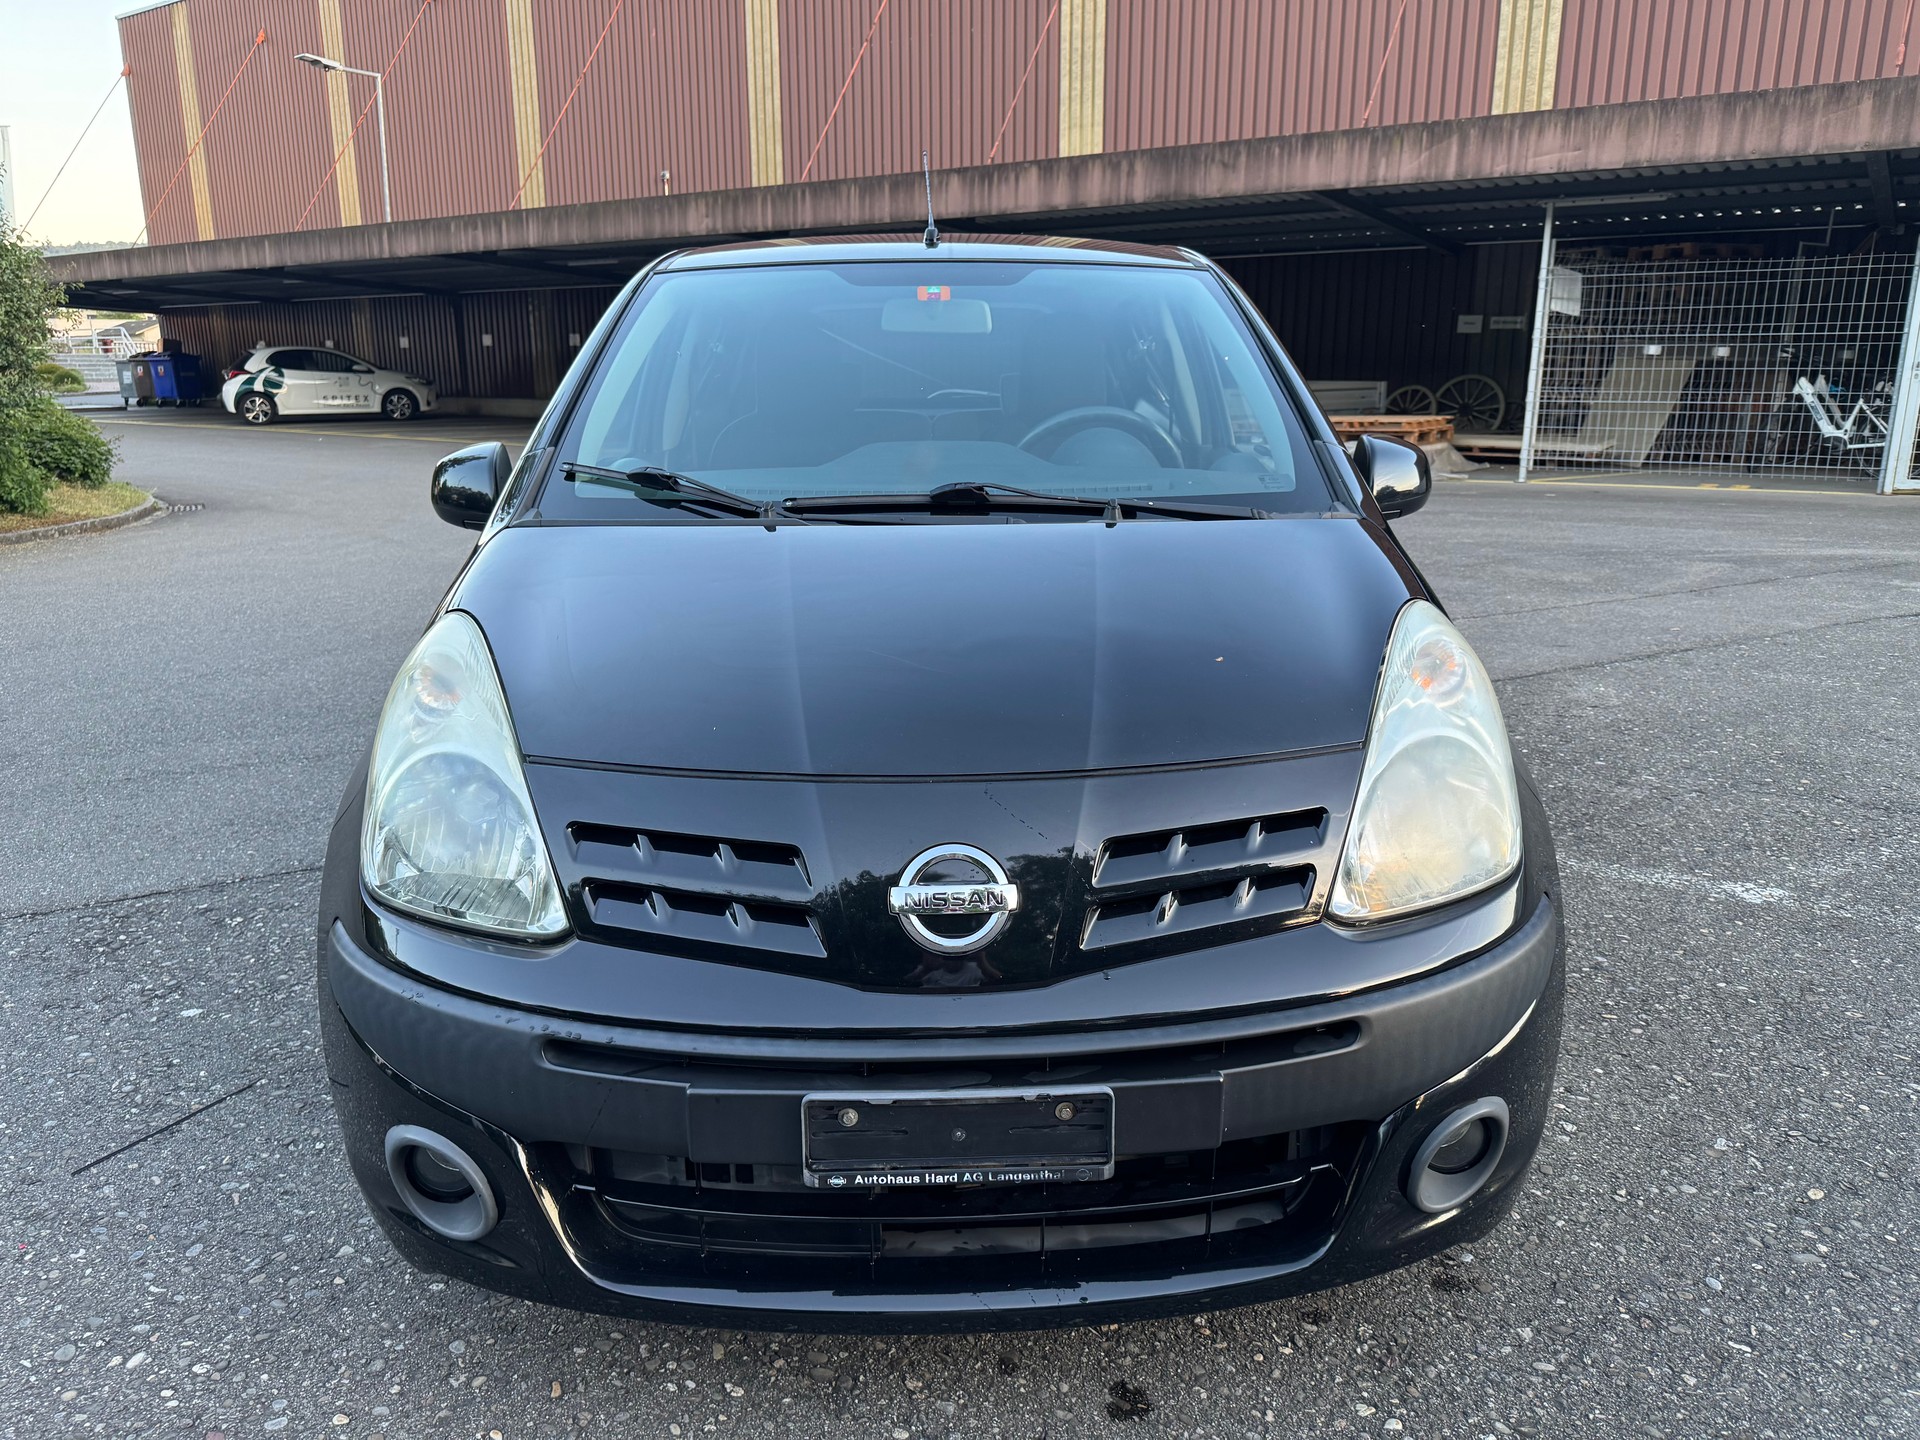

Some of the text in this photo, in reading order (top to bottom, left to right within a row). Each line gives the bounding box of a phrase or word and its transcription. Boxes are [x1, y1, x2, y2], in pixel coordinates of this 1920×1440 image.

[904, 891, 1004, 909] NISSAN
[854, 1173, 921, 1185] Autohaus
[925, 1172, 958, 1184] Hard
[963, 1172, 984, 1182] AG
